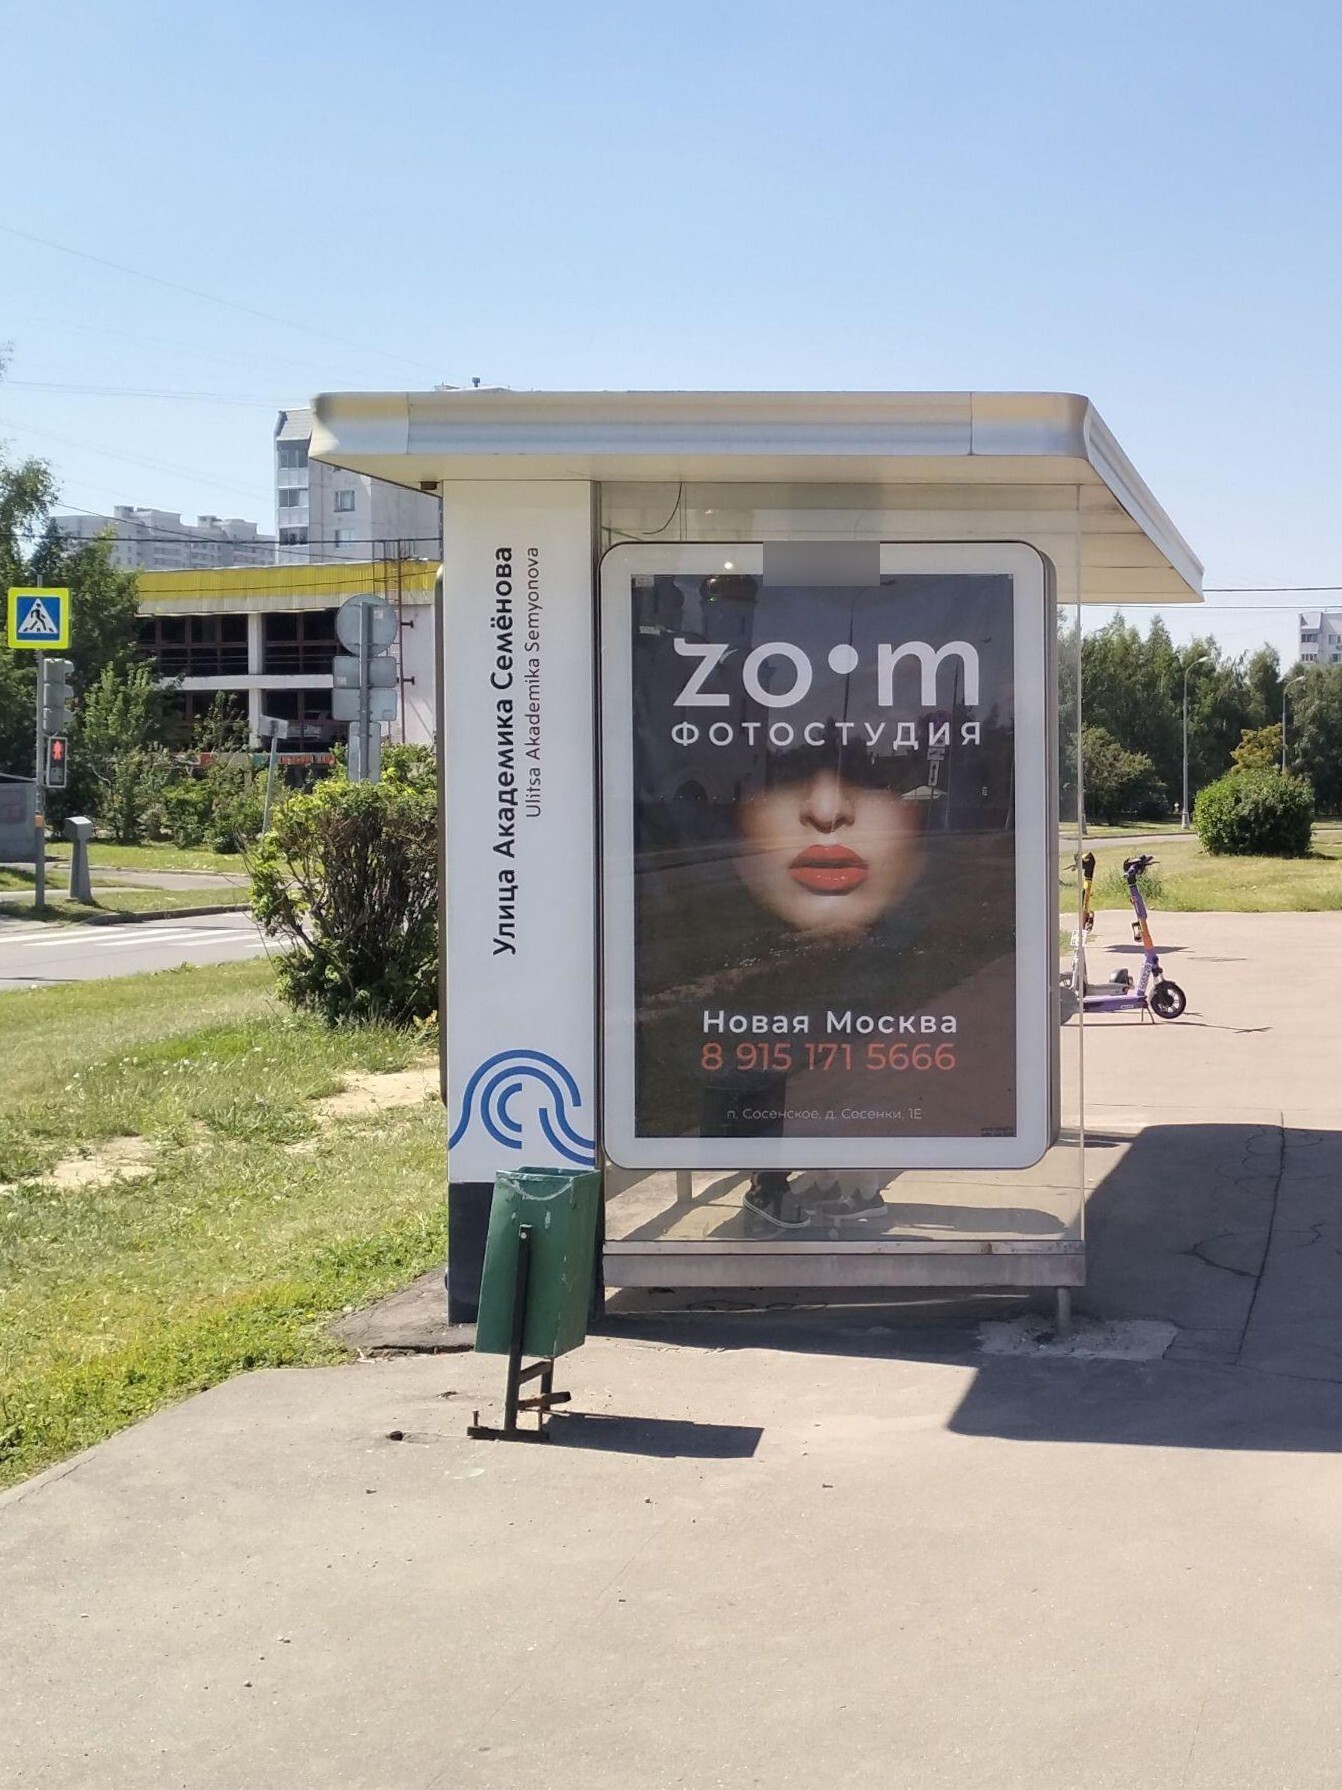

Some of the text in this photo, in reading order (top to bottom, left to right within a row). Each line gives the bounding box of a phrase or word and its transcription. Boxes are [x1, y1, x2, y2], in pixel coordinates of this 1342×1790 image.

[524, 547, 543, 818] Ulitsa Akademika Semyonova
[671, 721, 981, 751] ФОТОСТУДИЯ
[490, 547, 518, 956] Улица Академика Семёнова
[702, 1010, 957, 1034] Новая Москва
[701, 1042, 956, 1071] 8 915 171 5666
[742, 1108, 822, 1121] Сосенское,
[841, 1108, 906, 1121] Сосенки,
